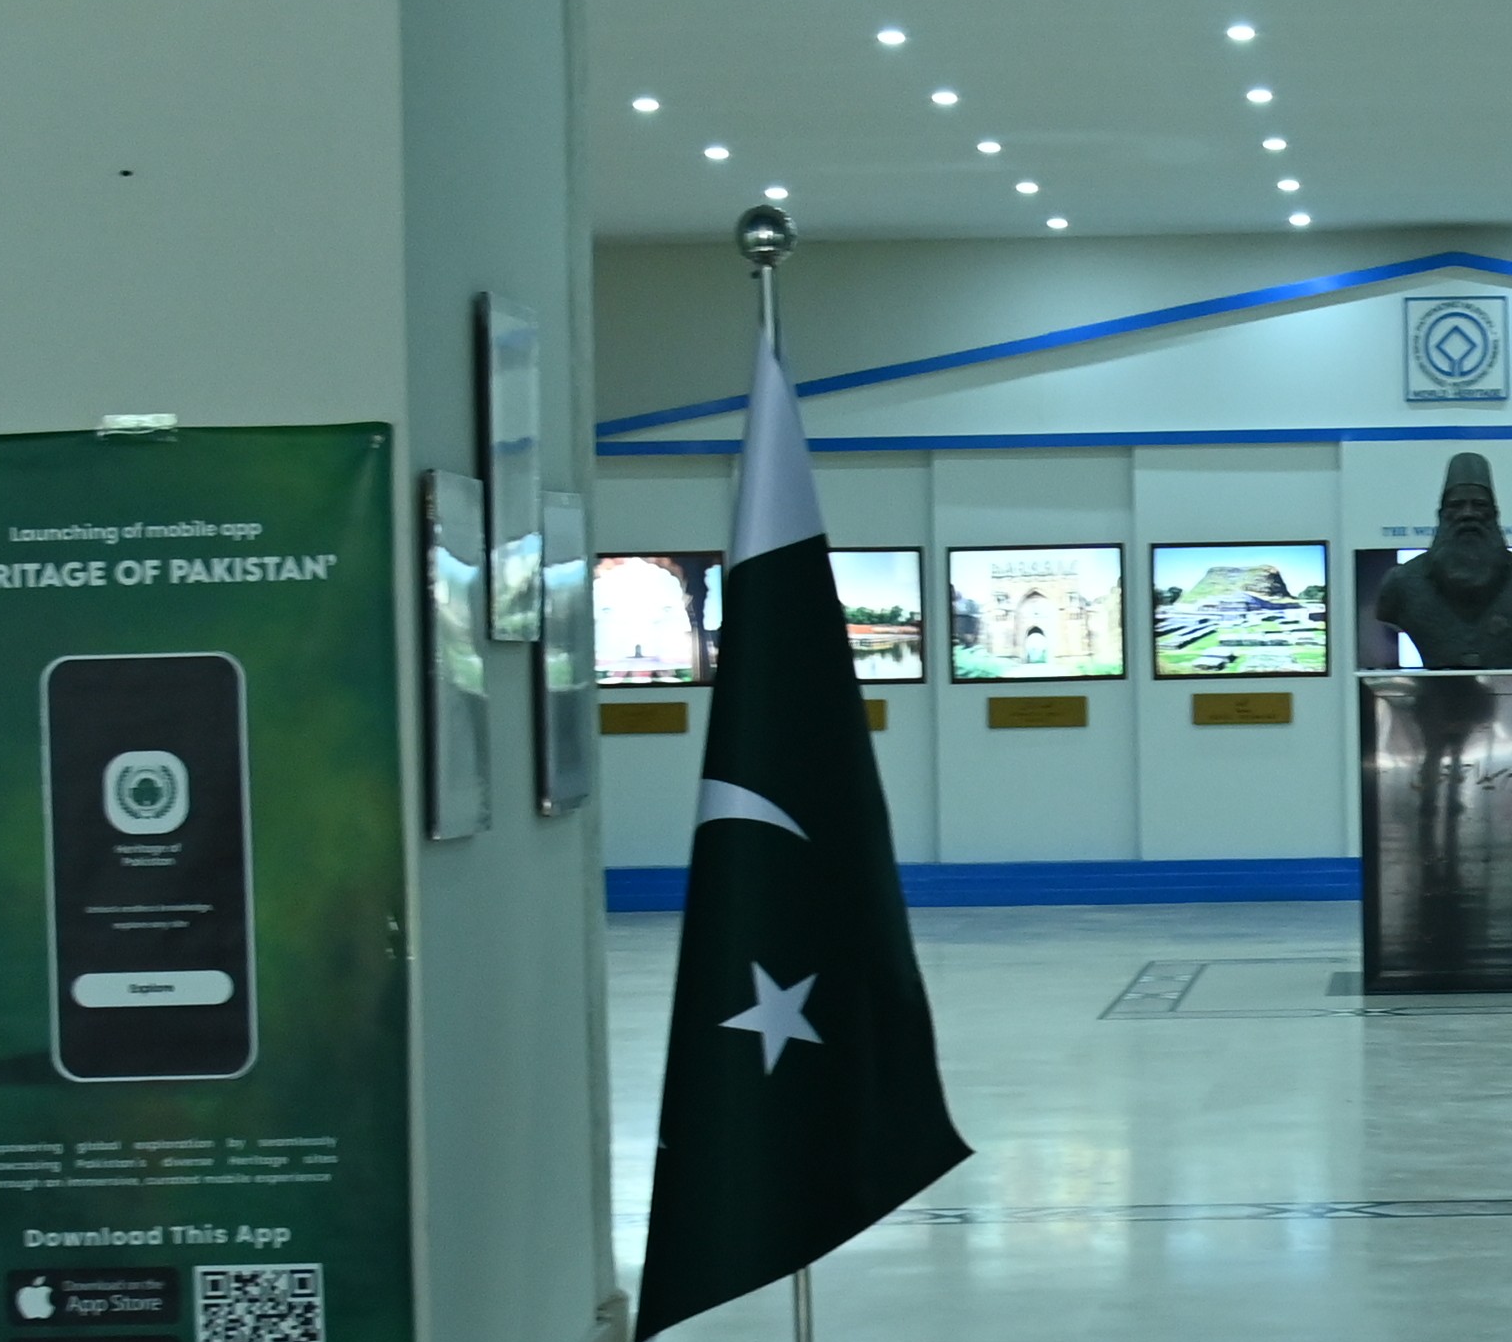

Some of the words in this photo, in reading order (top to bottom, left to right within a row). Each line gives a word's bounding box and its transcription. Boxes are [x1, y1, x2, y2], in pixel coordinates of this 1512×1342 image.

[9, 524, 119, 544] Launching
[122, 522, 143, 539] of
[145, 520, 216, 538] mobile
[220, 521, 263, 540] app
[114, 560, 160, 586] OF
[24, 1227, 161, 1248] Download
[171, 1225, 228, 1246] This
[235, 1225, 291, 1248] App
[66, 1296, 109, 1316] App
[109, 1294, 163, 1311] Store
